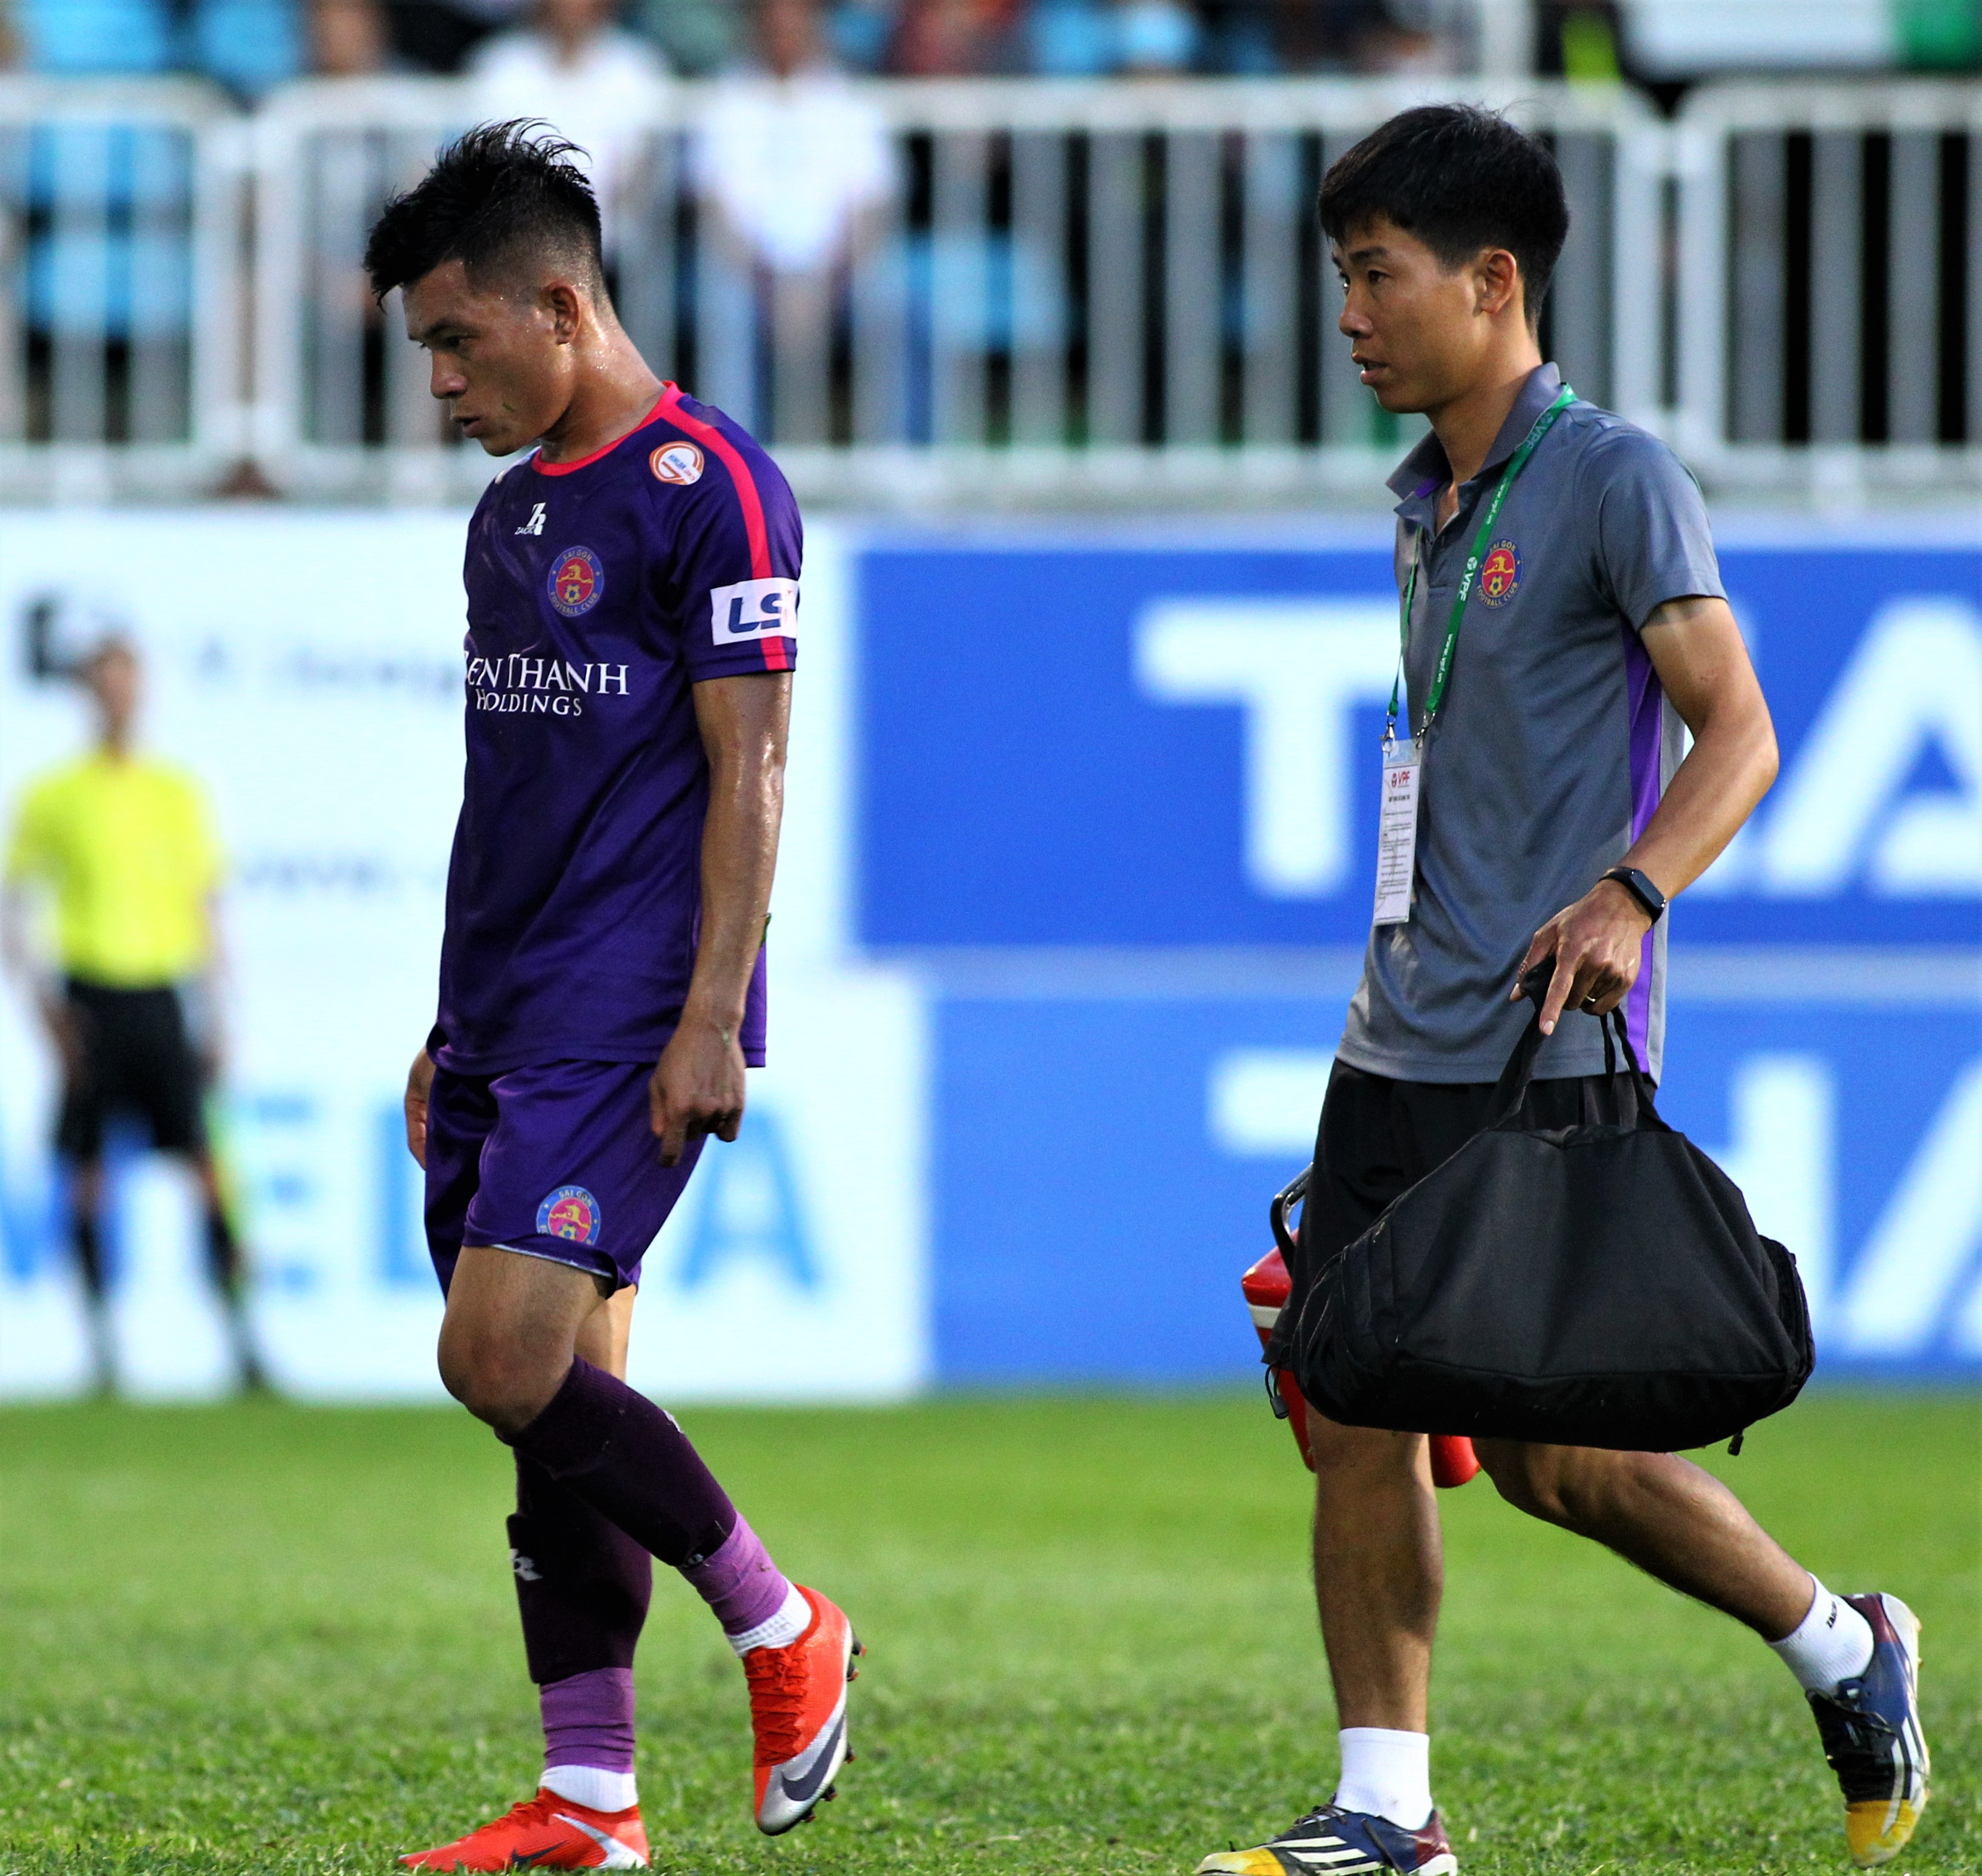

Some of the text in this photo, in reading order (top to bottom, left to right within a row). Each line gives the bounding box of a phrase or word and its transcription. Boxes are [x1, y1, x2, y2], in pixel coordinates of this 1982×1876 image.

[1459, 572, 1474, 602] VPF
[1477, 582, 1518, 607] FOOTBALL CLUB
[550, 591, 598, 614] FOOTBALL CLUB
[464, 650, 630, 695] ENTHANH
[475, 689, 583, 717] HOLDINGS
